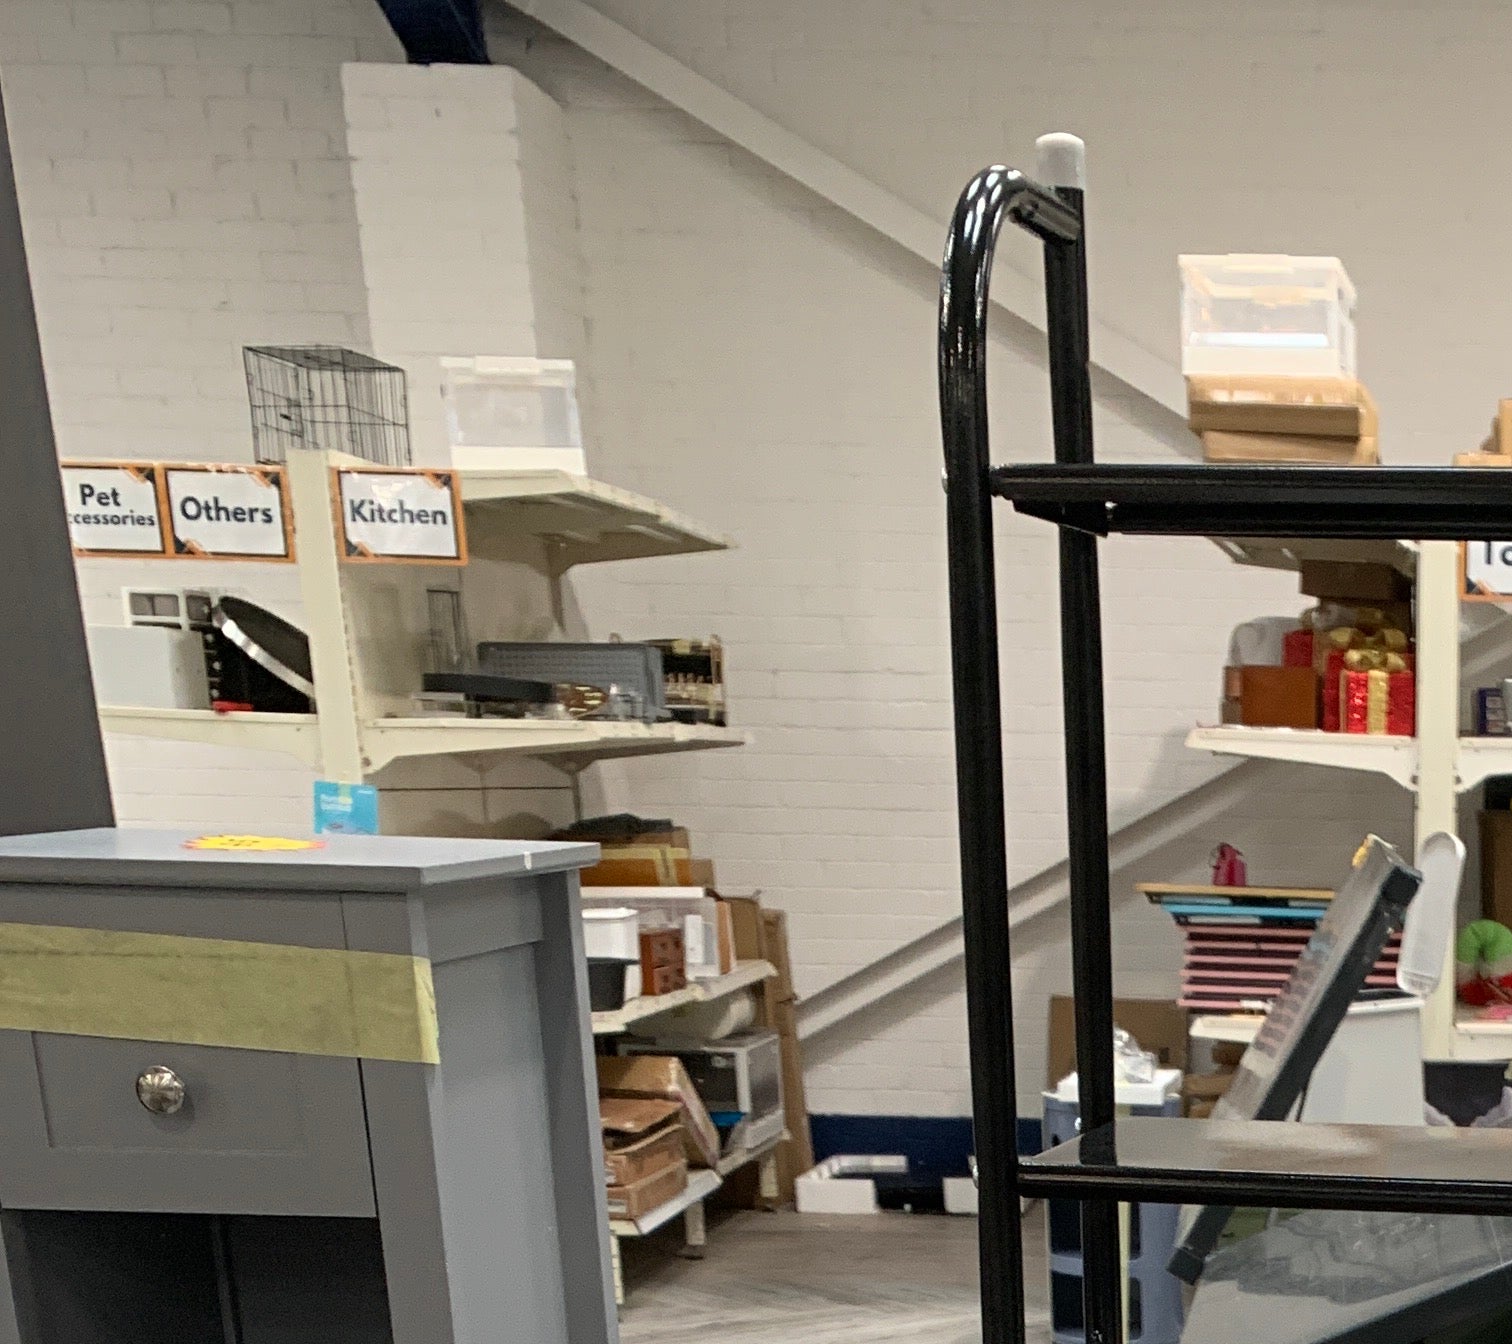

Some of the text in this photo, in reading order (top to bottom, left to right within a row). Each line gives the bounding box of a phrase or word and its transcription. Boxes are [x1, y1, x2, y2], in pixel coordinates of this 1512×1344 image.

[79, 483, 121, 507] Pet
[180, 496, 273, 524] Others
[349, 499, 447, 525] Kitchen
